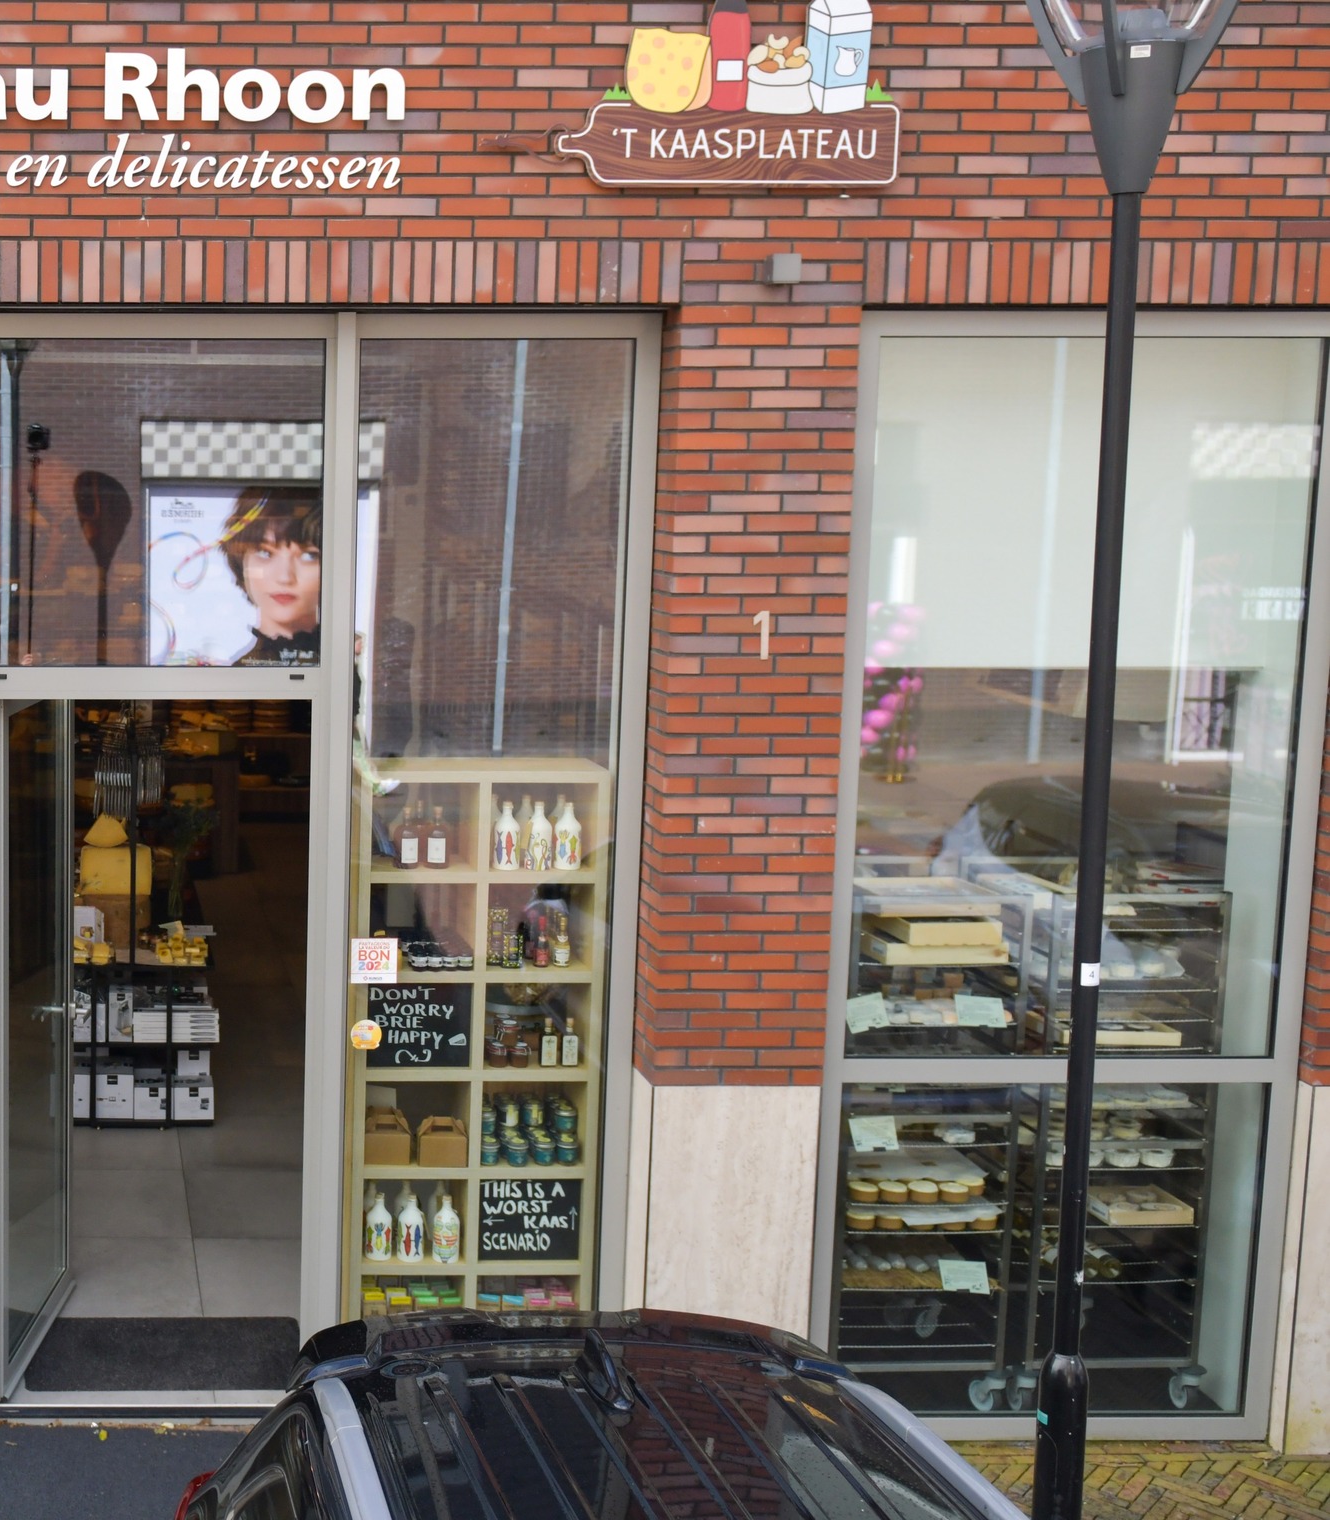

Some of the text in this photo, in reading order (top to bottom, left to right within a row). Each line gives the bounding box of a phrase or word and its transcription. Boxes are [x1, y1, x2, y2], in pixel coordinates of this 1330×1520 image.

[104, 48, 407, 123] Rhoon
[650, 128, 879, 160] KAASPLATEAU
[6, 154, 68, 189] en
[87, 133, 401, 191] delicatessen
[752, 610, 771, 661] 1
[358, 950, 390, 961] BON
[358, 961, 390, 971] 2024
[1088, 970, 1095, 978] 4
[370, 986, 436, 1001] DON'T
[382, 1002, 454, 1019] WORRY
[387, 1029, 444, 1050] HAPPY
[551, 1181, 566, 1197] A
[482, 1200, 553, 1215] WORST
[523, 1214, 569, 1229] KAAS
